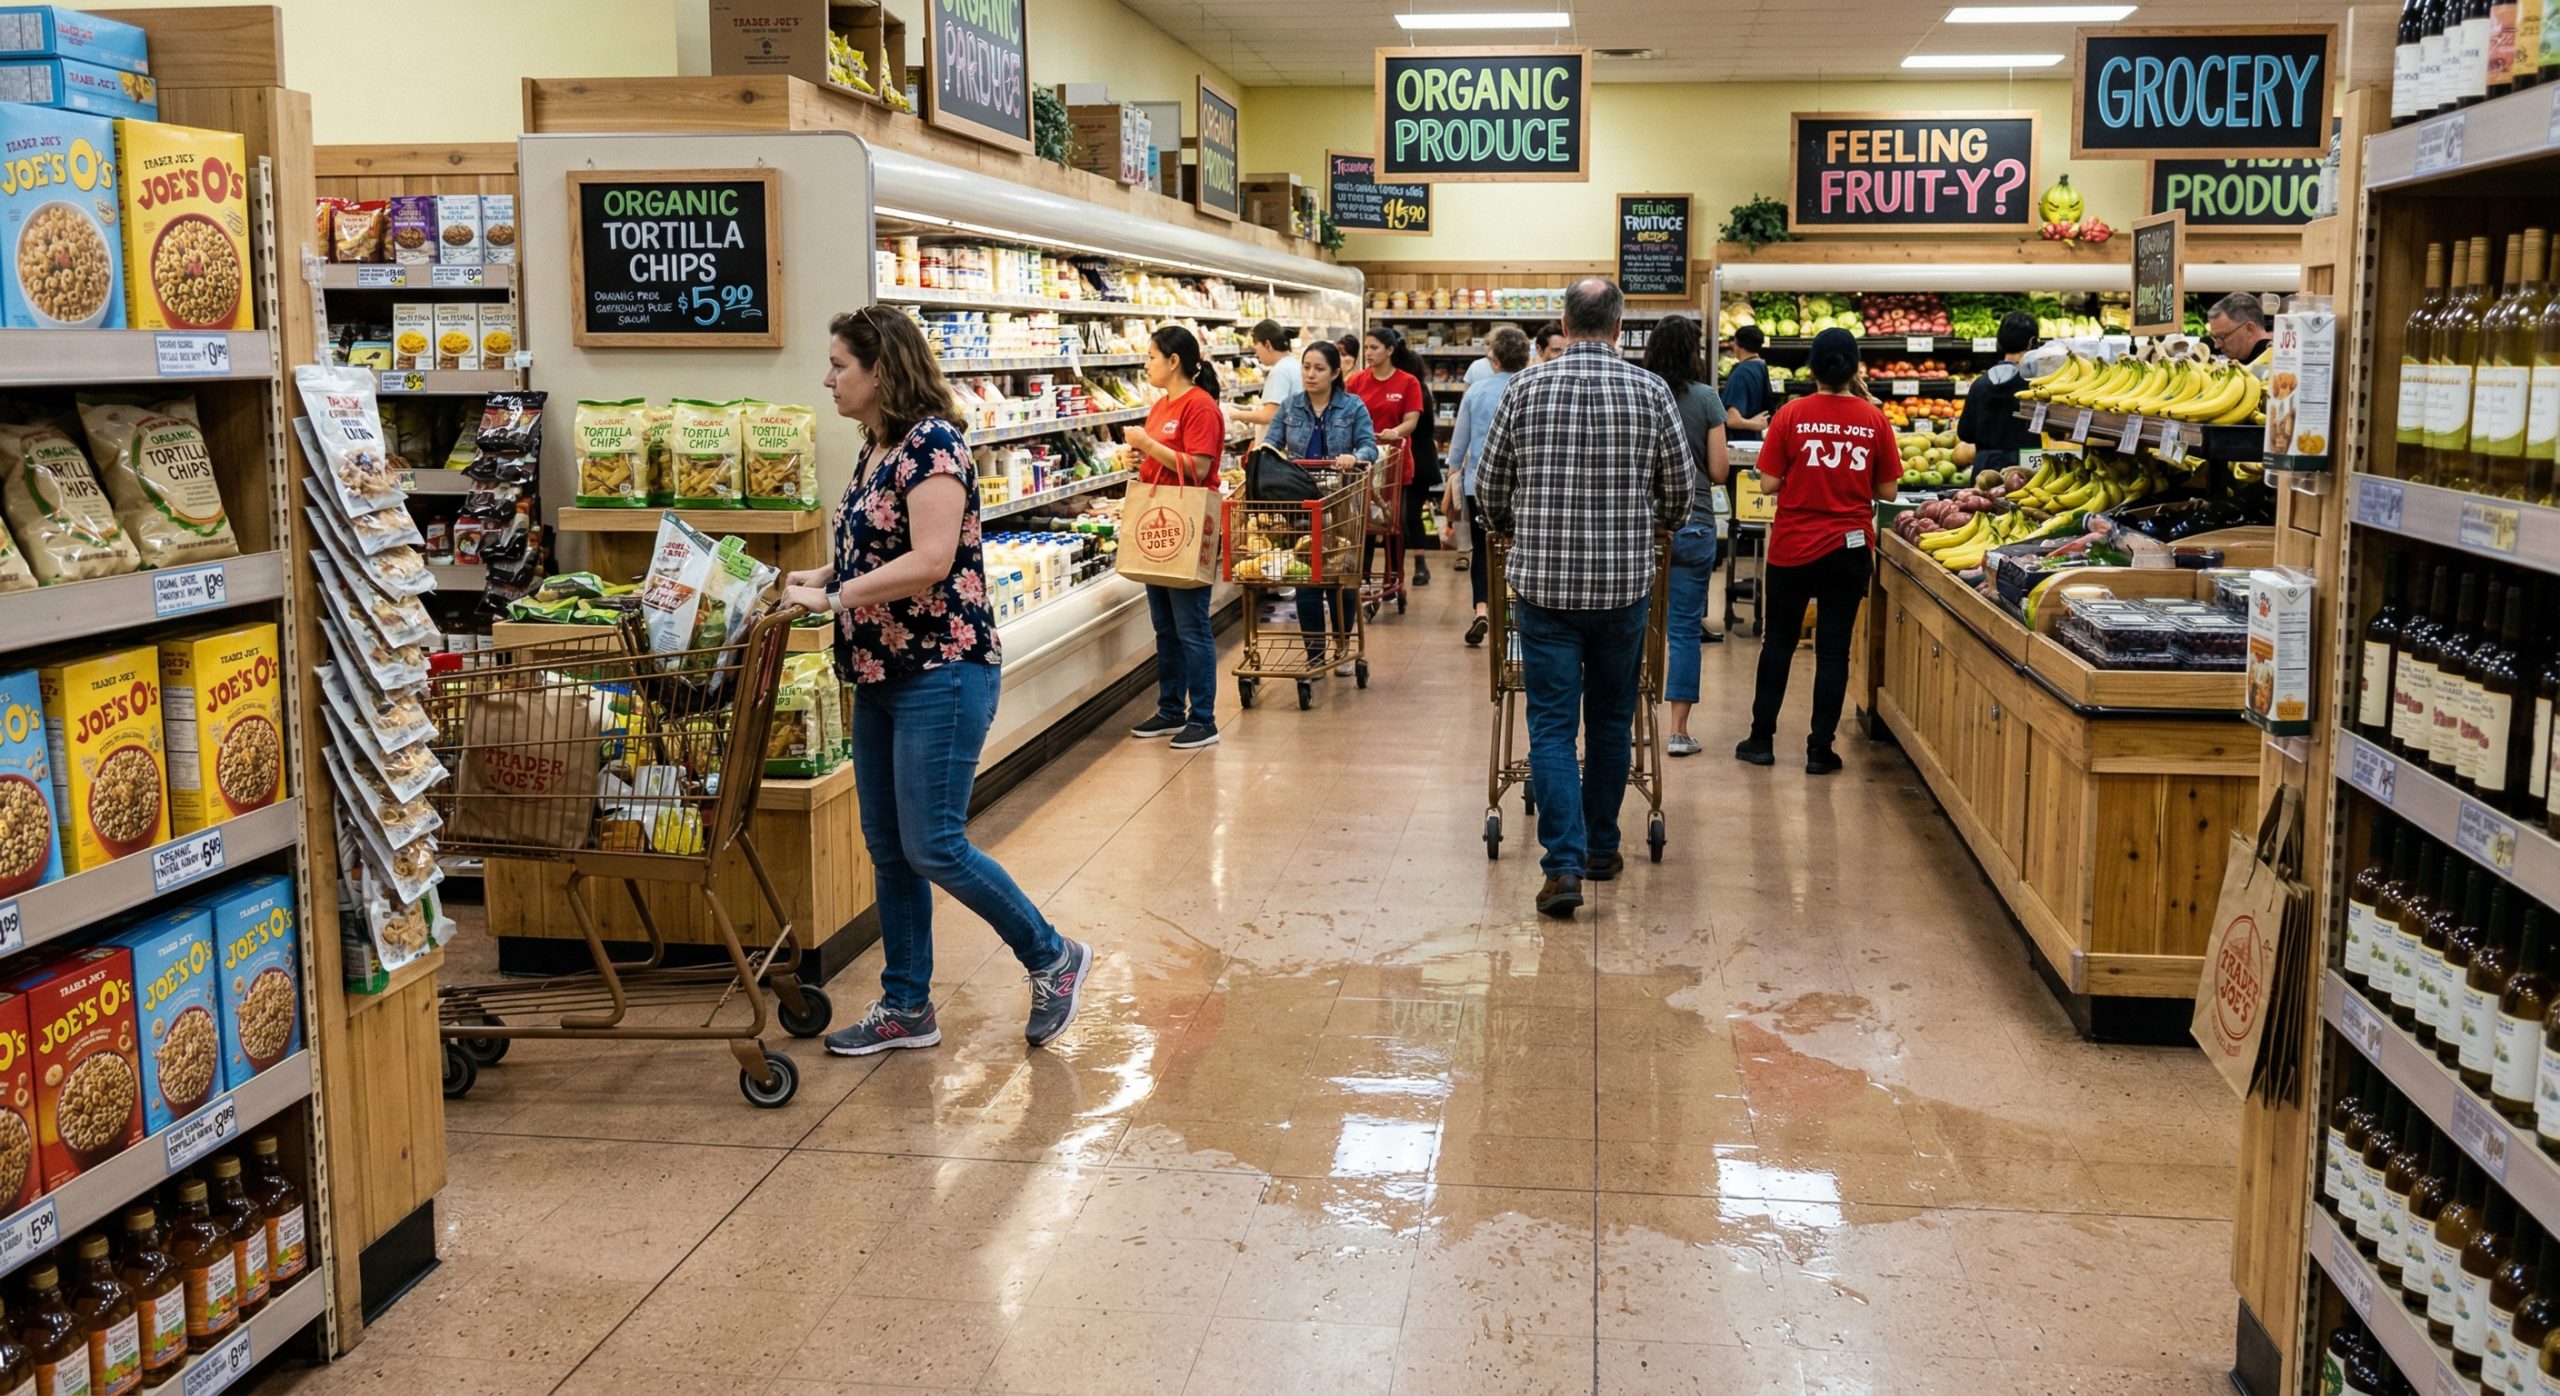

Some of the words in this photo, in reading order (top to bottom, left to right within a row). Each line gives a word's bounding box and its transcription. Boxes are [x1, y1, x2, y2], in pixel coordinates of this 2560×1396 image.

[1395, 67, 1570, 112] ORGANIC
[2098, 54, 2320, 129] GROCERY
[1394, 118, 1570, 162] PRODUCE
[1826, 128, 1989, 164] FEELING
[1, 152, 67, 196] JOE'S
[137, 167, 200, 211] JOE'S
[1820, 159, 2027, 216] FRUIT-Y?
[603, 189, 739, 217] ORGANIC
[1632, 204, 1676, 215] FEELING
[602, 220, 745, 250] TORTILLA
[629, 252, 717, 283] CHIPS
[583, 426, 632, 438] TORTILLA
[590, 437, 622, 448] CHIPS
[682, 427, 730, 438] TORTILLA
[689, 438, 720, 449] CHIPS
[752, 425, 799, 437] TORTILLA
[758, 437, 789, 448] CHIPS
[1796, 422, 1841, 435] TRADER
[146, 443, 210, 467] TORTILLA
[167, 461, 211, 481] CHIPS
[1800, 439, 1870, 471] TJ'S
[206, 668, 253, 714] JOE'S
[76, 694, 129, 744] JOE'S
[485, 748, 564, 776] TRADER
[224, 920, 270, 970] JOE'S
[144, 956, 190, 1012] JOE'S
[2219, 948, 2260, 1005] TRADER
[2219, 979, 2252, 1024] JOE'S
[38, 997, 99, 1054] JOE'S
